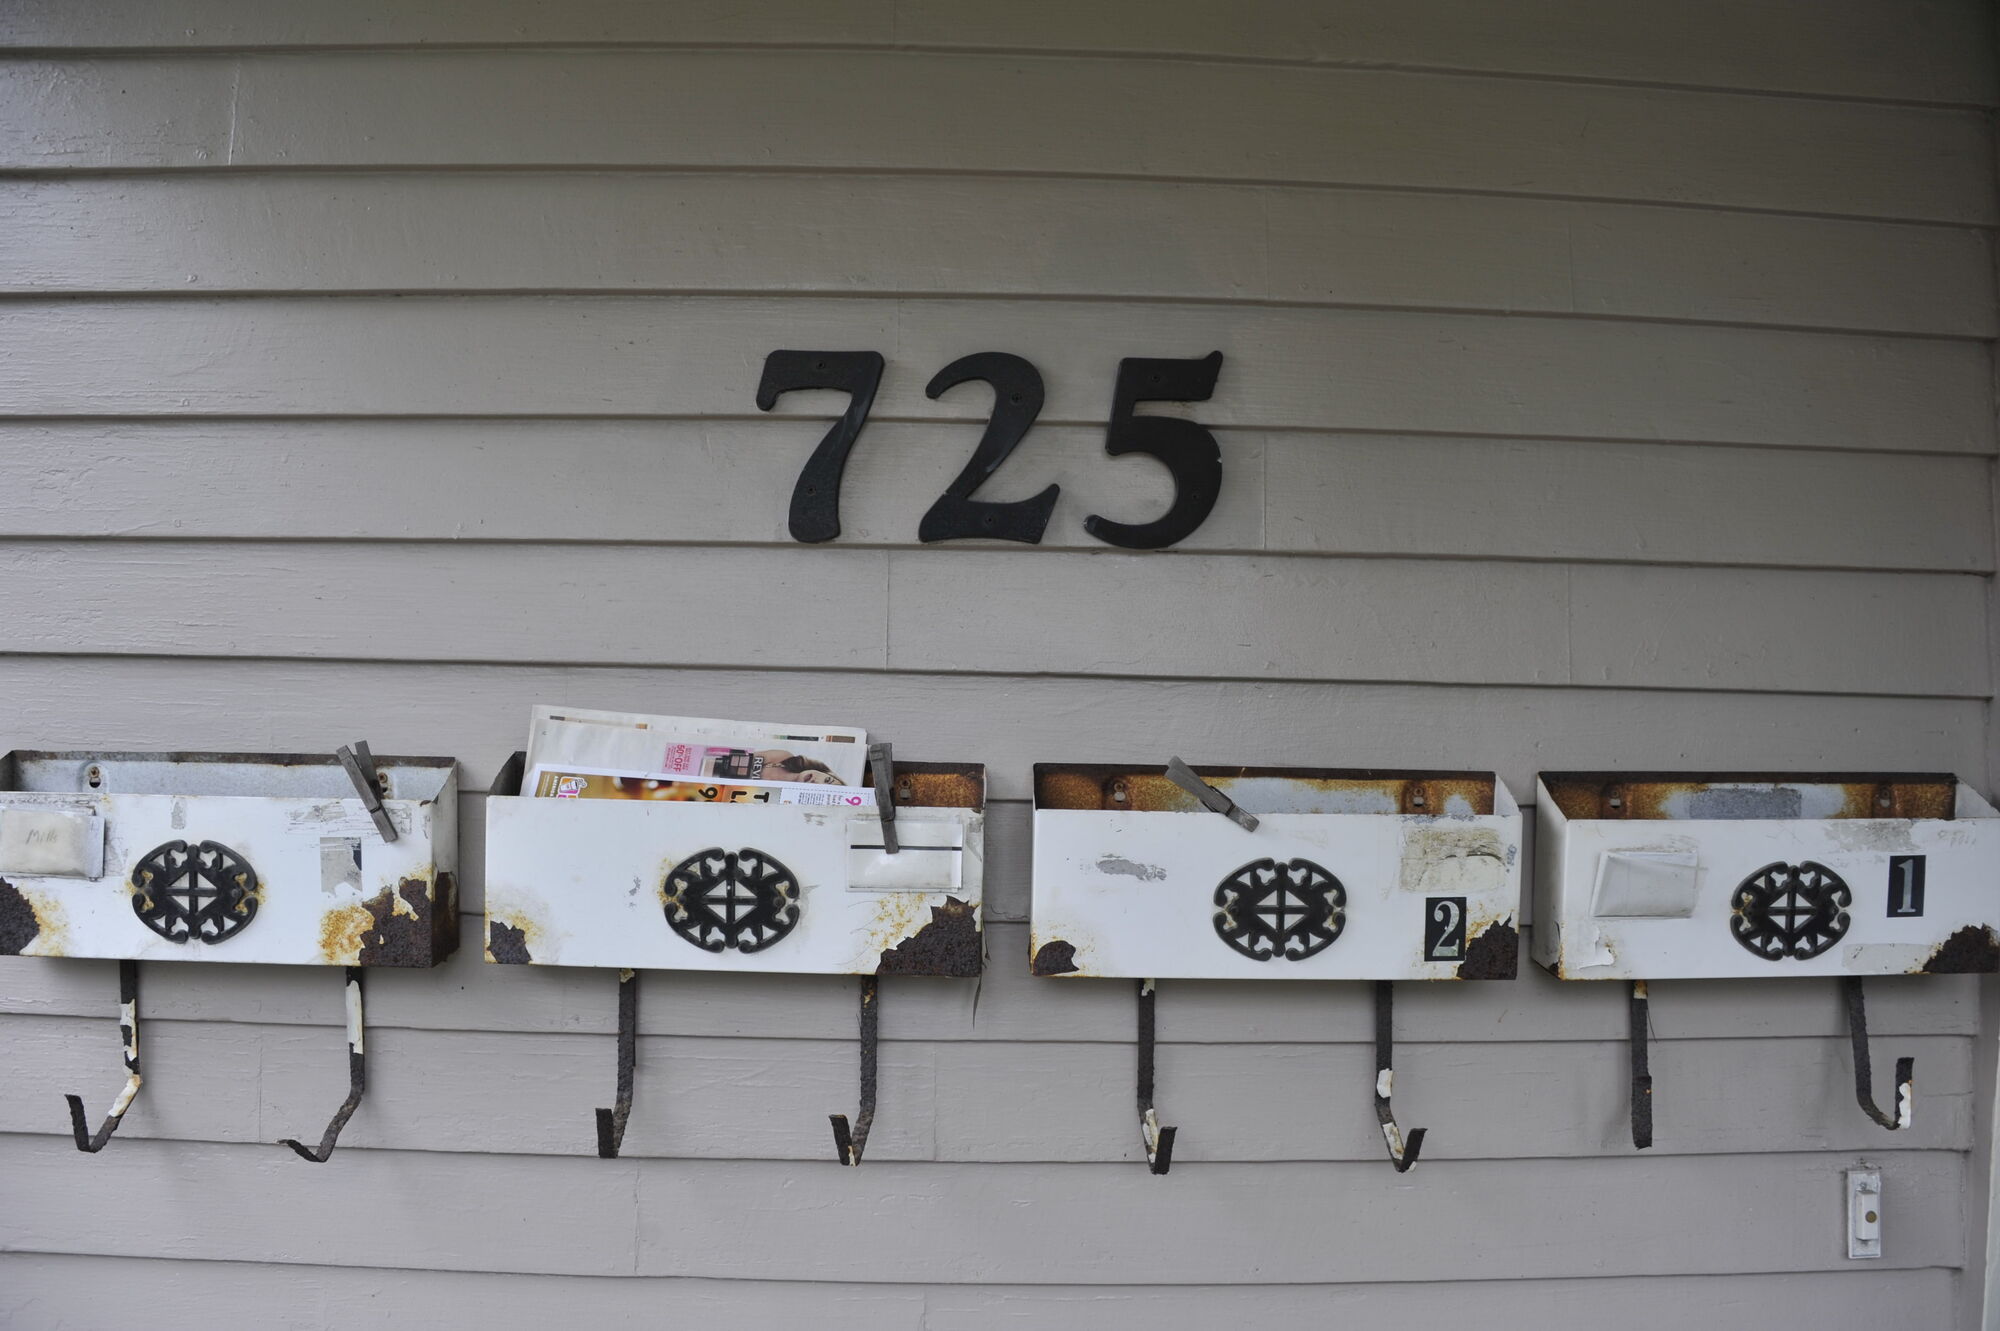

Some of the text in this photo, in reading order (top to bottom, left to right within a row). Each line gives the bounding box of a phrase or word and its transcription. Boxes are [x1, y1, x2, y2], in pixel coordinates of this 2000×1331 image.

[756, 349, 1224, 549] 725
[1897, 859, 1917, 913] 1
[1432, 900, 1460, 957] 2
